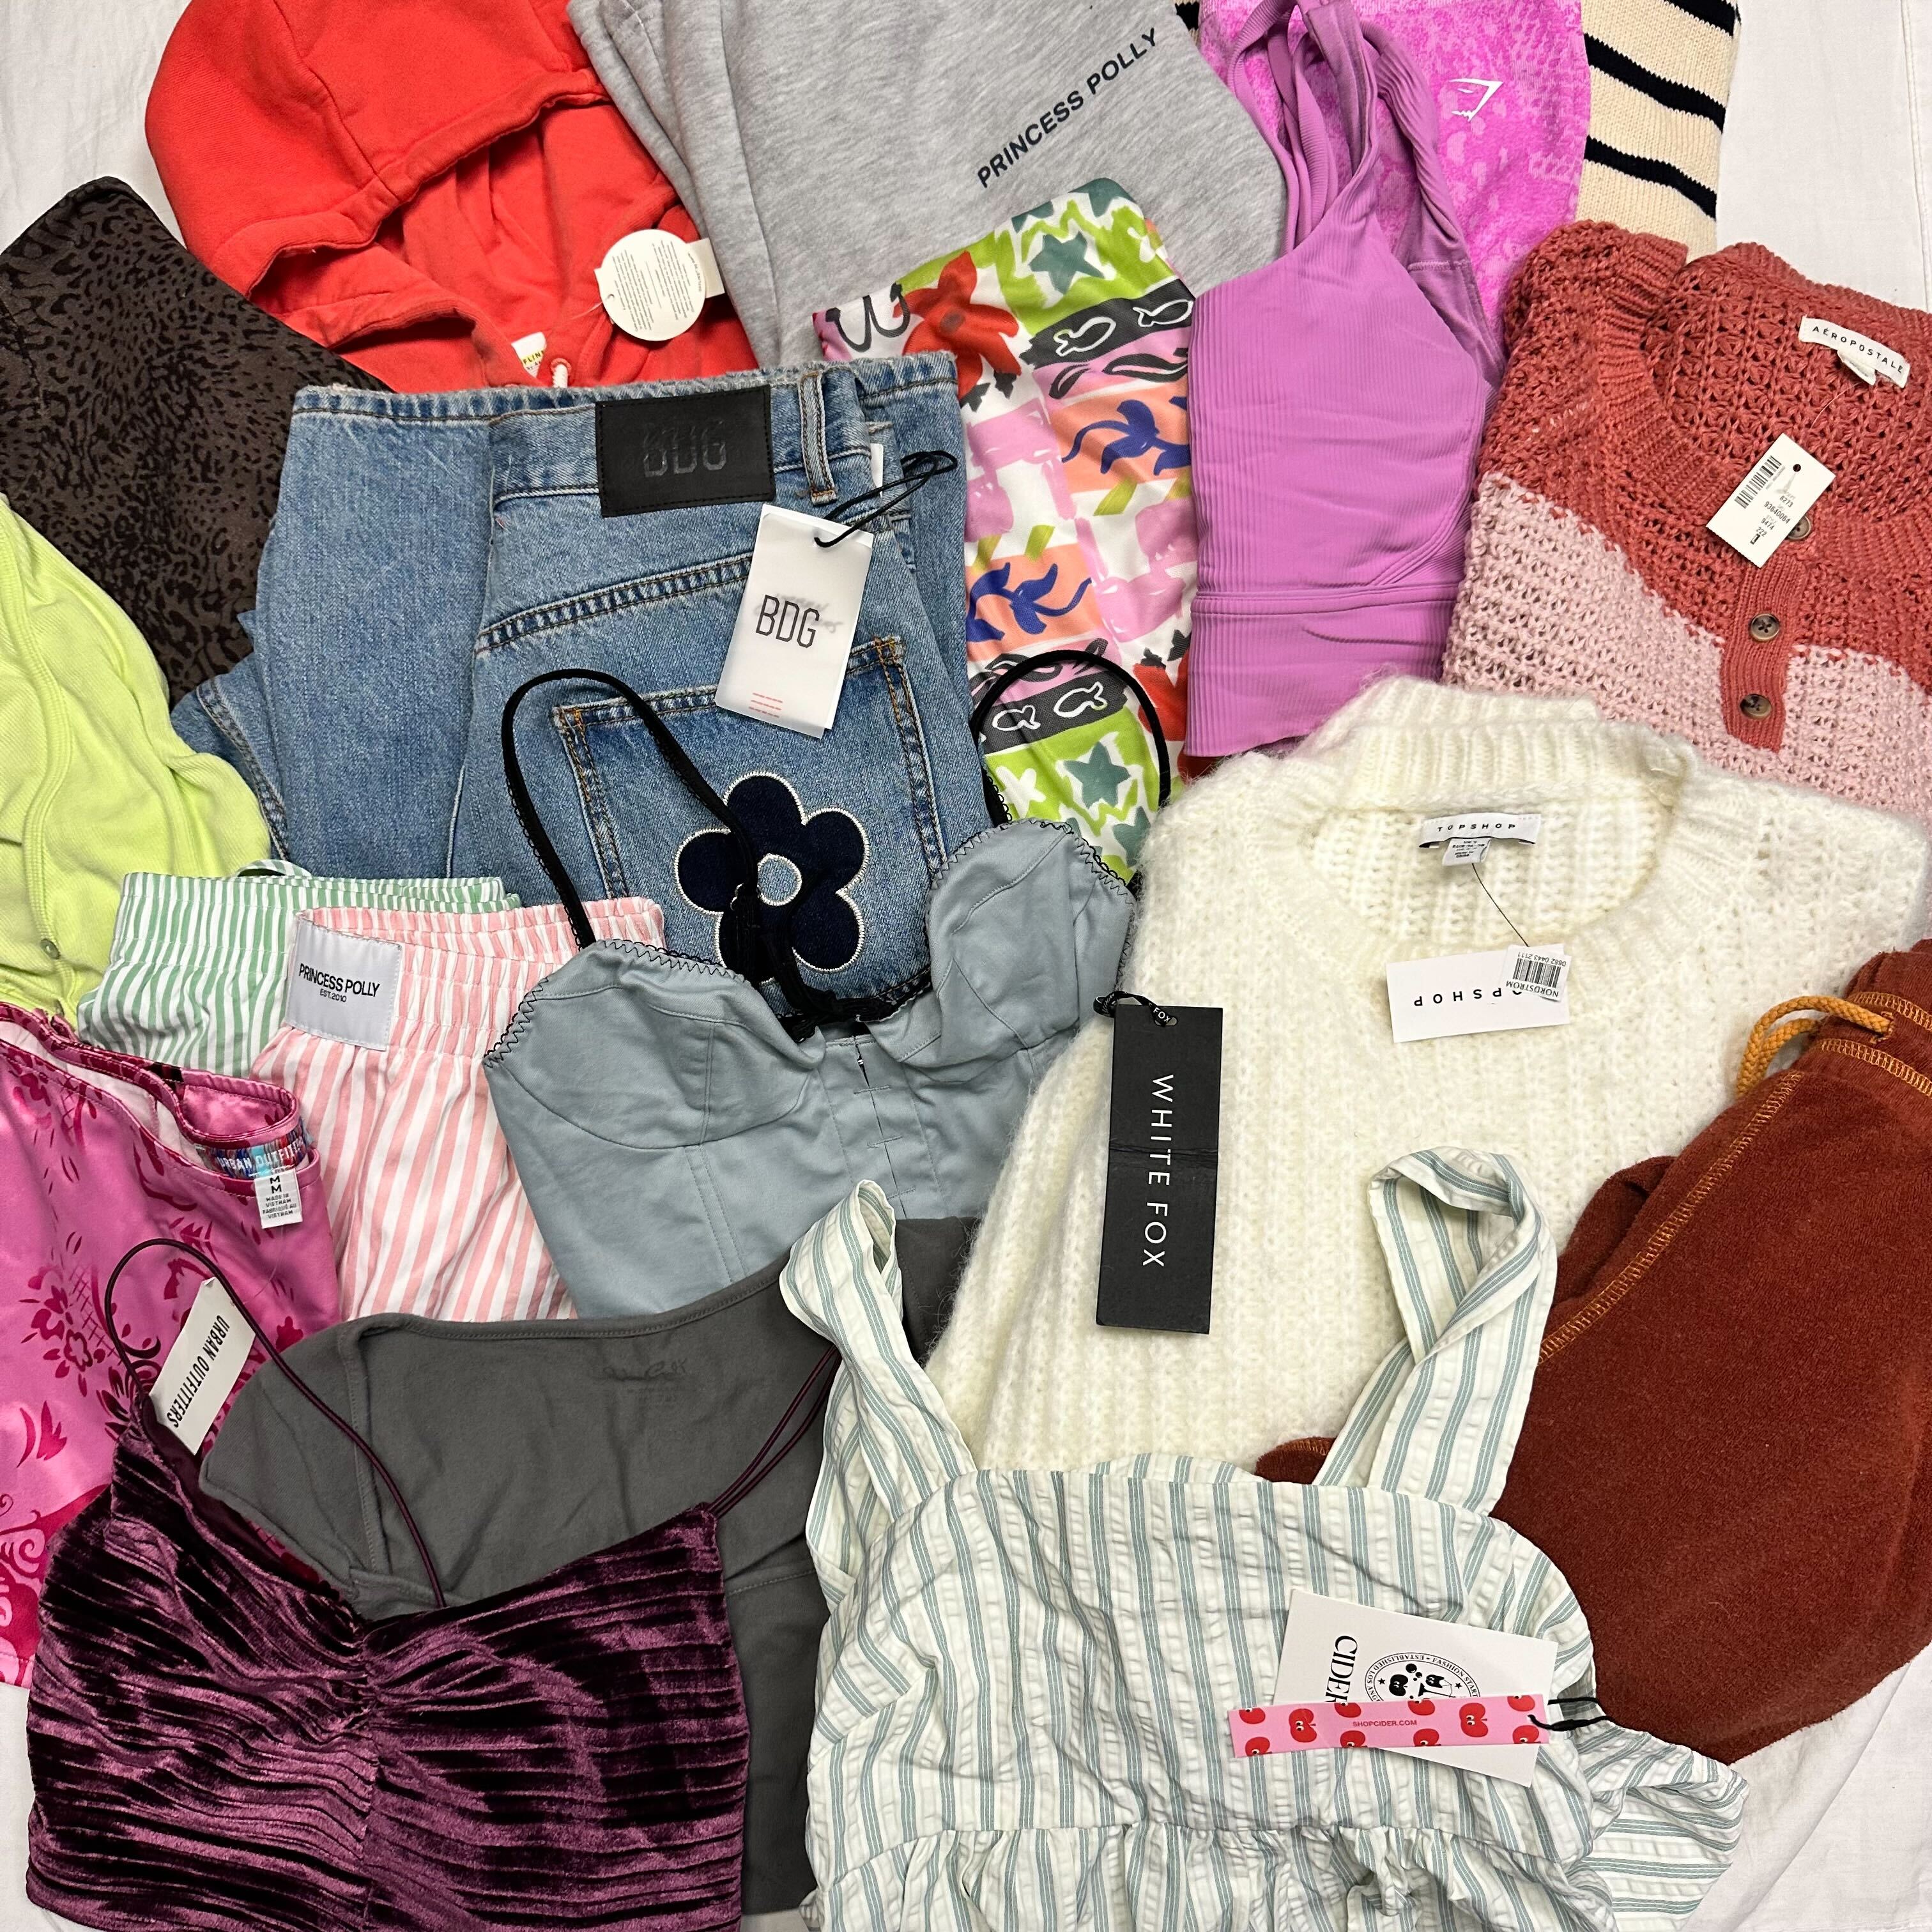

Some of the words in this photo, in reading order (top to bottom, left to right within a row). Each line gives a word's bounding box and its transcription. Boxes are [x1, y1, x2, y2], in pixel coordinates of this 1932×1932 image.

[977, 90, 1084, 188] PRINCESS
[1086, 27, 1156, 95] POLLY
[1812, 326, 1903, 373] AÉROPOSTALE
[643, 420, 727, 478] BDG
[1756, 526, 1767, 537] 222
[1761, 518, 1775, 530] 9474
[755, 594, 820, 648] BDG
[1438, 823, 1515, 832] TOPSHOP
[298, 963, 344, 992] PRINCESS
[344, 979, 381, 997] POLLY
[1505, 980, 1559, 997] NORDSTROM
[1413, 986, 1522, 1006] PSHOP
[1153, 1007, 1171, 1023] FOX
[1148, 1074, 1174, 1186] WHITE
[270, 1176, 280, 1184] M
[271, 1184, 282, 1193] M
[1142, 1202, 1169, 1268] FOX
[203, 1315, 230, 1361] URBAN
[167, 1356, 210, 1428] OUTFITTERS
[1374, 1653, 1424, 1670] ESTABLISHED
[1432, 1657, 1464, 1677] FASHION
[1367, 1670, 1376, 1684] LOS
